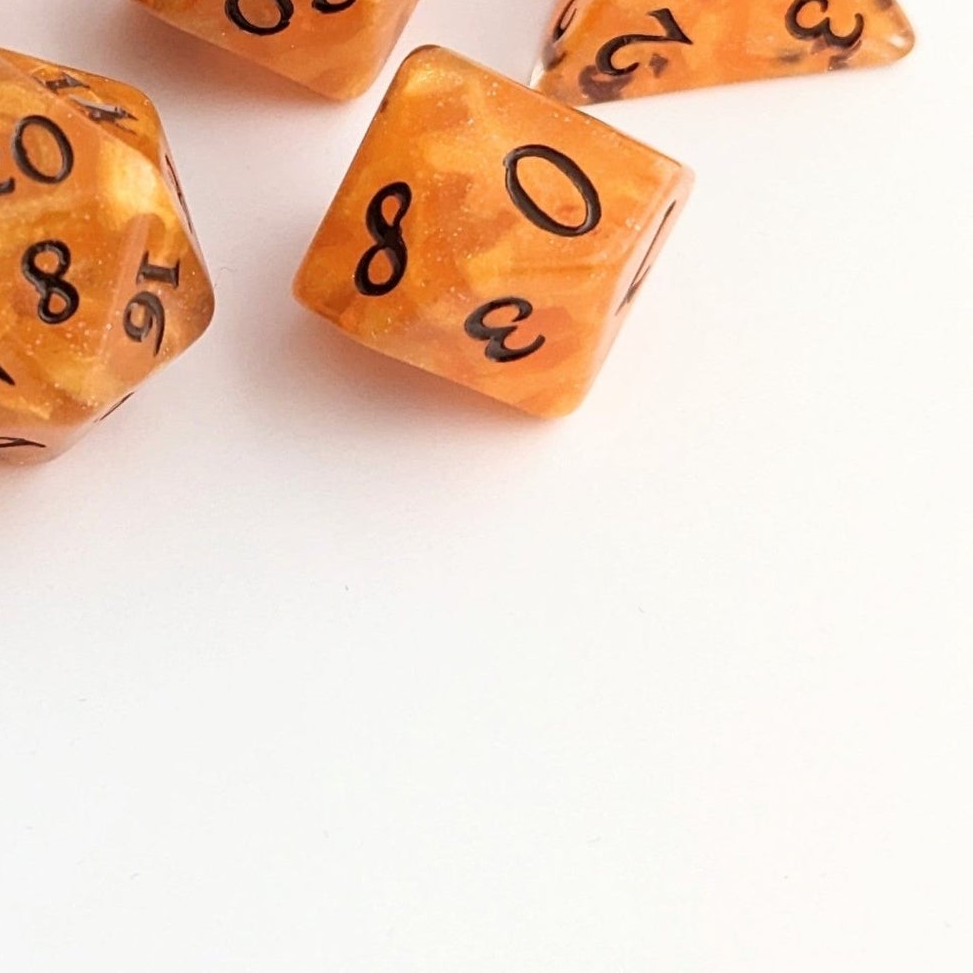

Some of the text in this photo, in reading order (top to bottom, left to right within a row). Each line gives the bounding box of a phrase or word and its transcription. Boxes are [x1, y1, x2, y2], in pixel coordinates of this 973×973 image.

[594, 7, 694, 77] 2
[502, 143, 603, 238] 0
[22, 240, 80, 325] 8
[354, 182, 412, 296] 8
[125, 253, 180, 354] 16
[468, 297, 545, 363] 3
